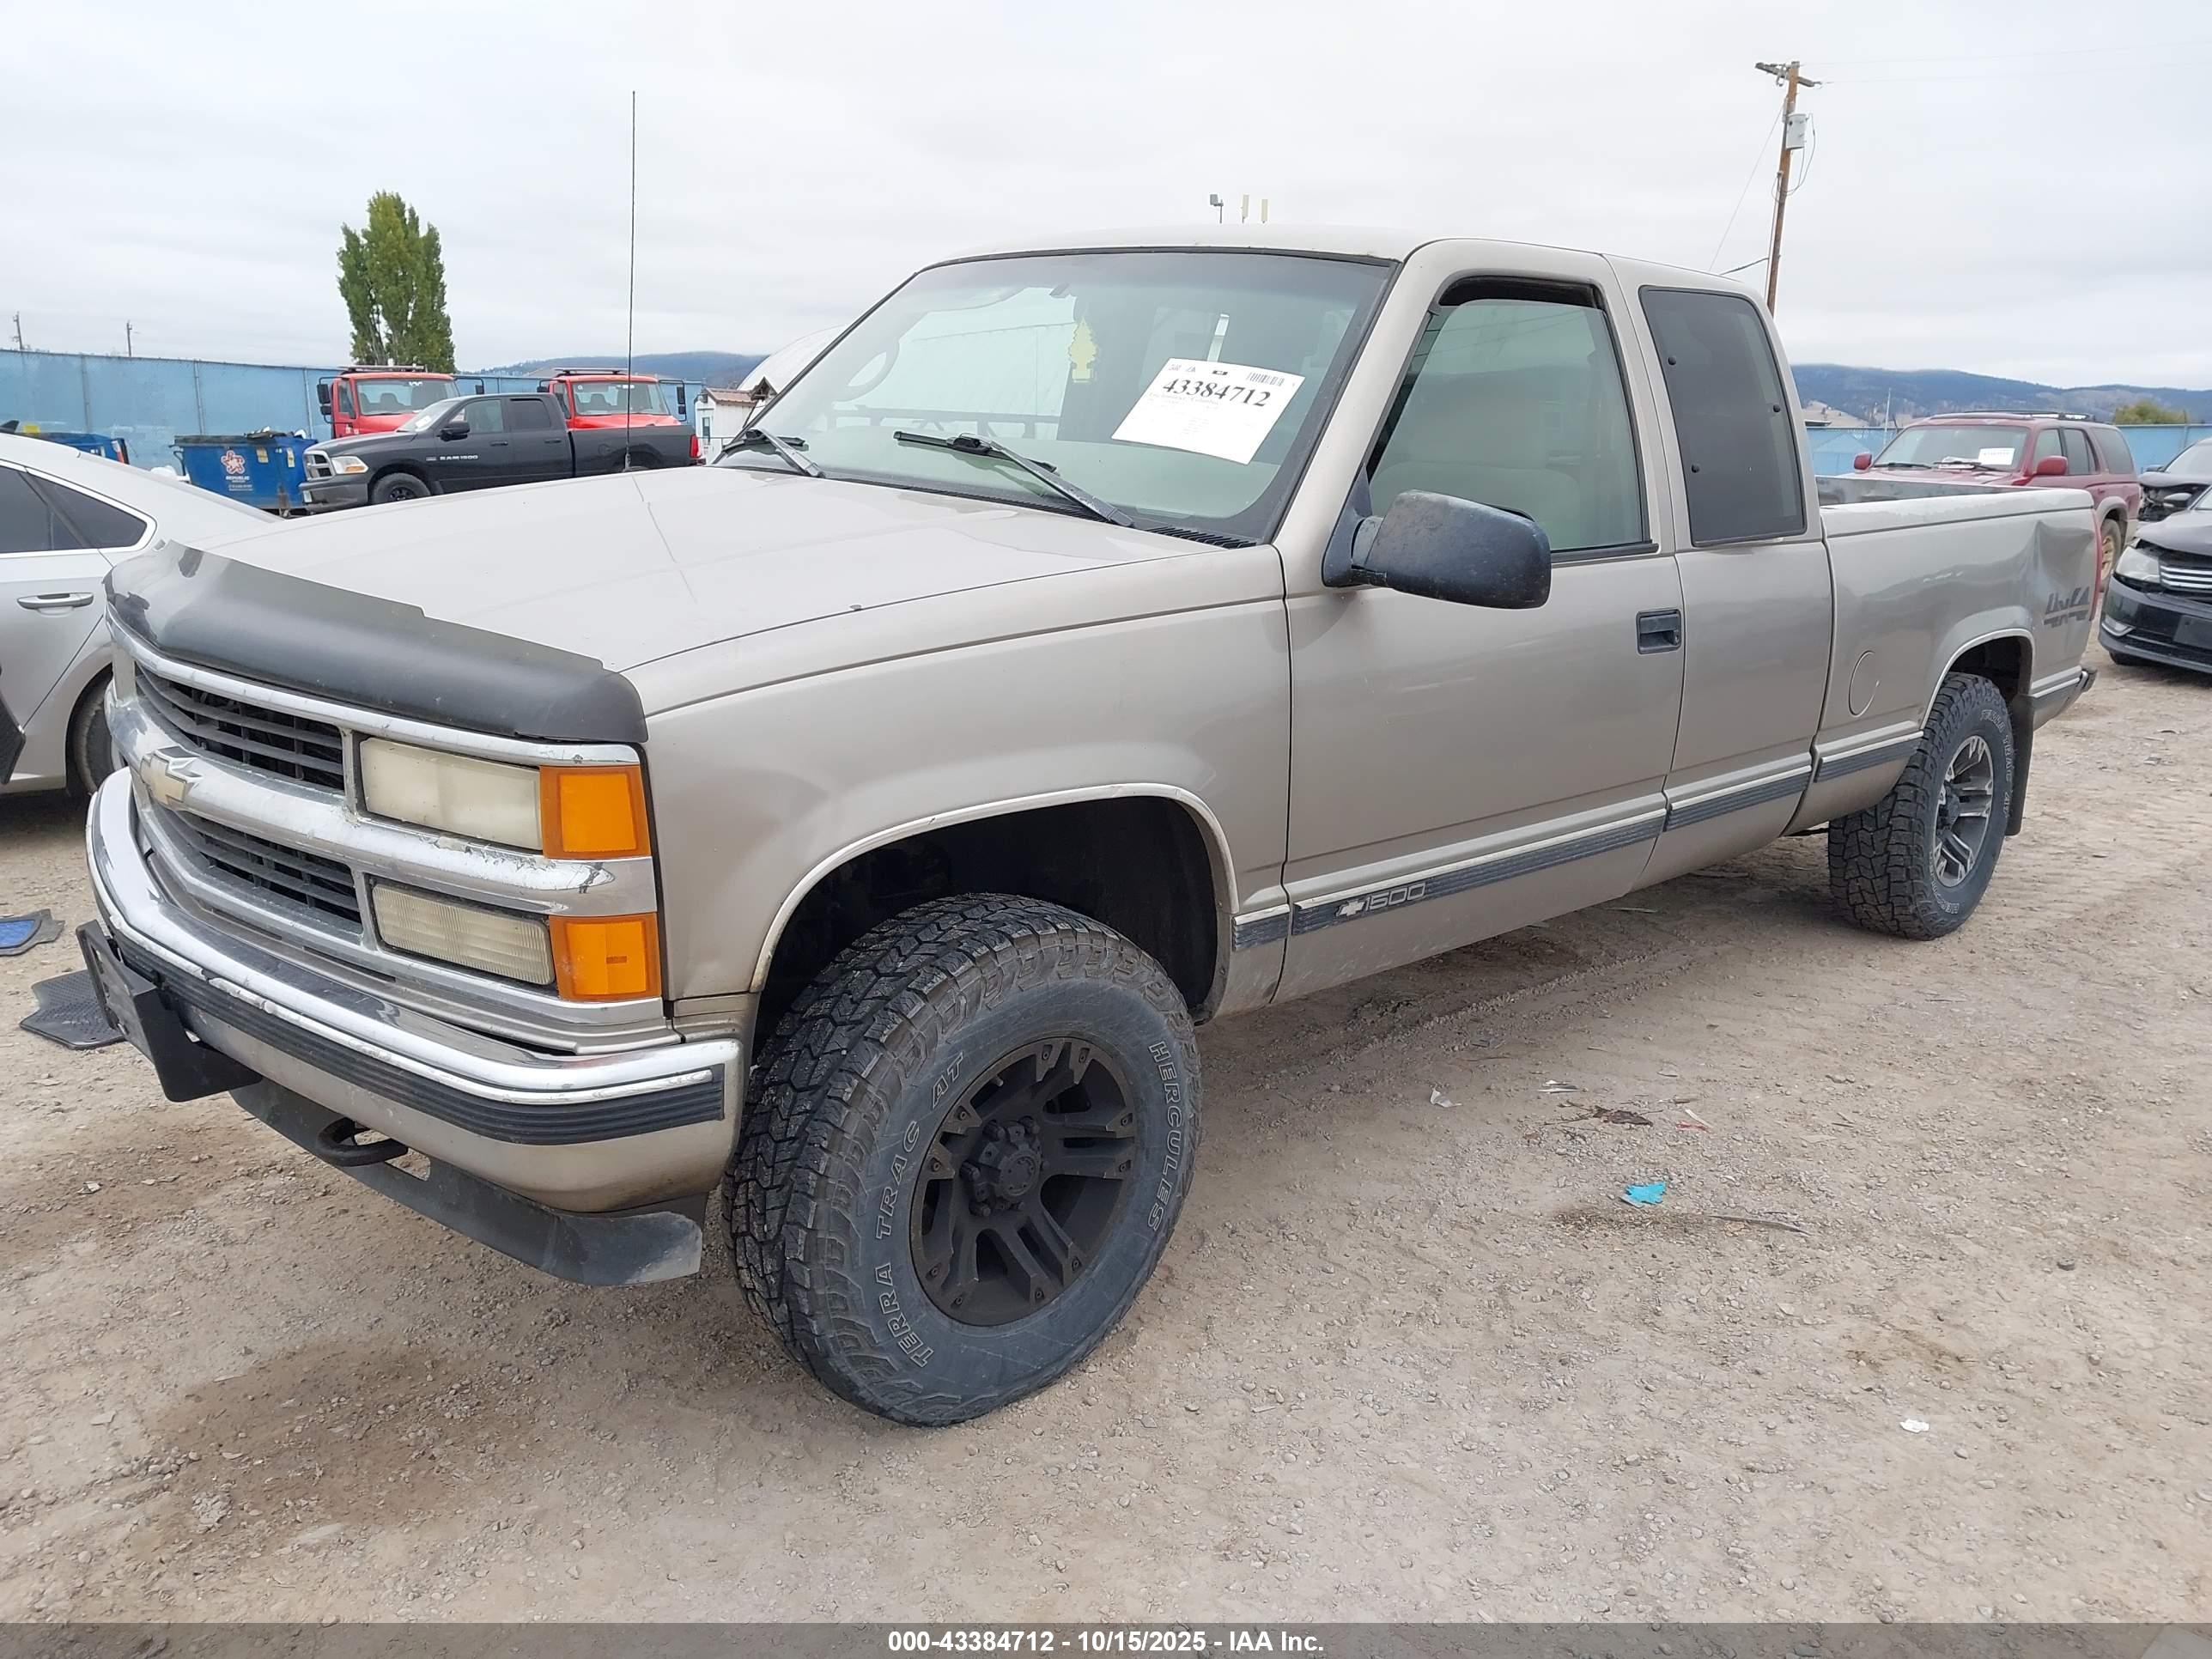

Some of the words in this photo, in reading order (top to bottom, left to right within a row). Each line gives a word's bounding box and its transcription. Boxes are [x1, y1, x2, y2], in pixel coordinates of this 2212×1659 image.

[1163, 379, 1272, 407] 43384712
[1364, 882, 1426, 912] 1500
[932, 1051, 964, 1109] AT
[1147, 1040, 1182, 1232] HERCULES
[875, 1120, 920, 1240] TRAC
[875, 1261, 934, 1368] TERRA
